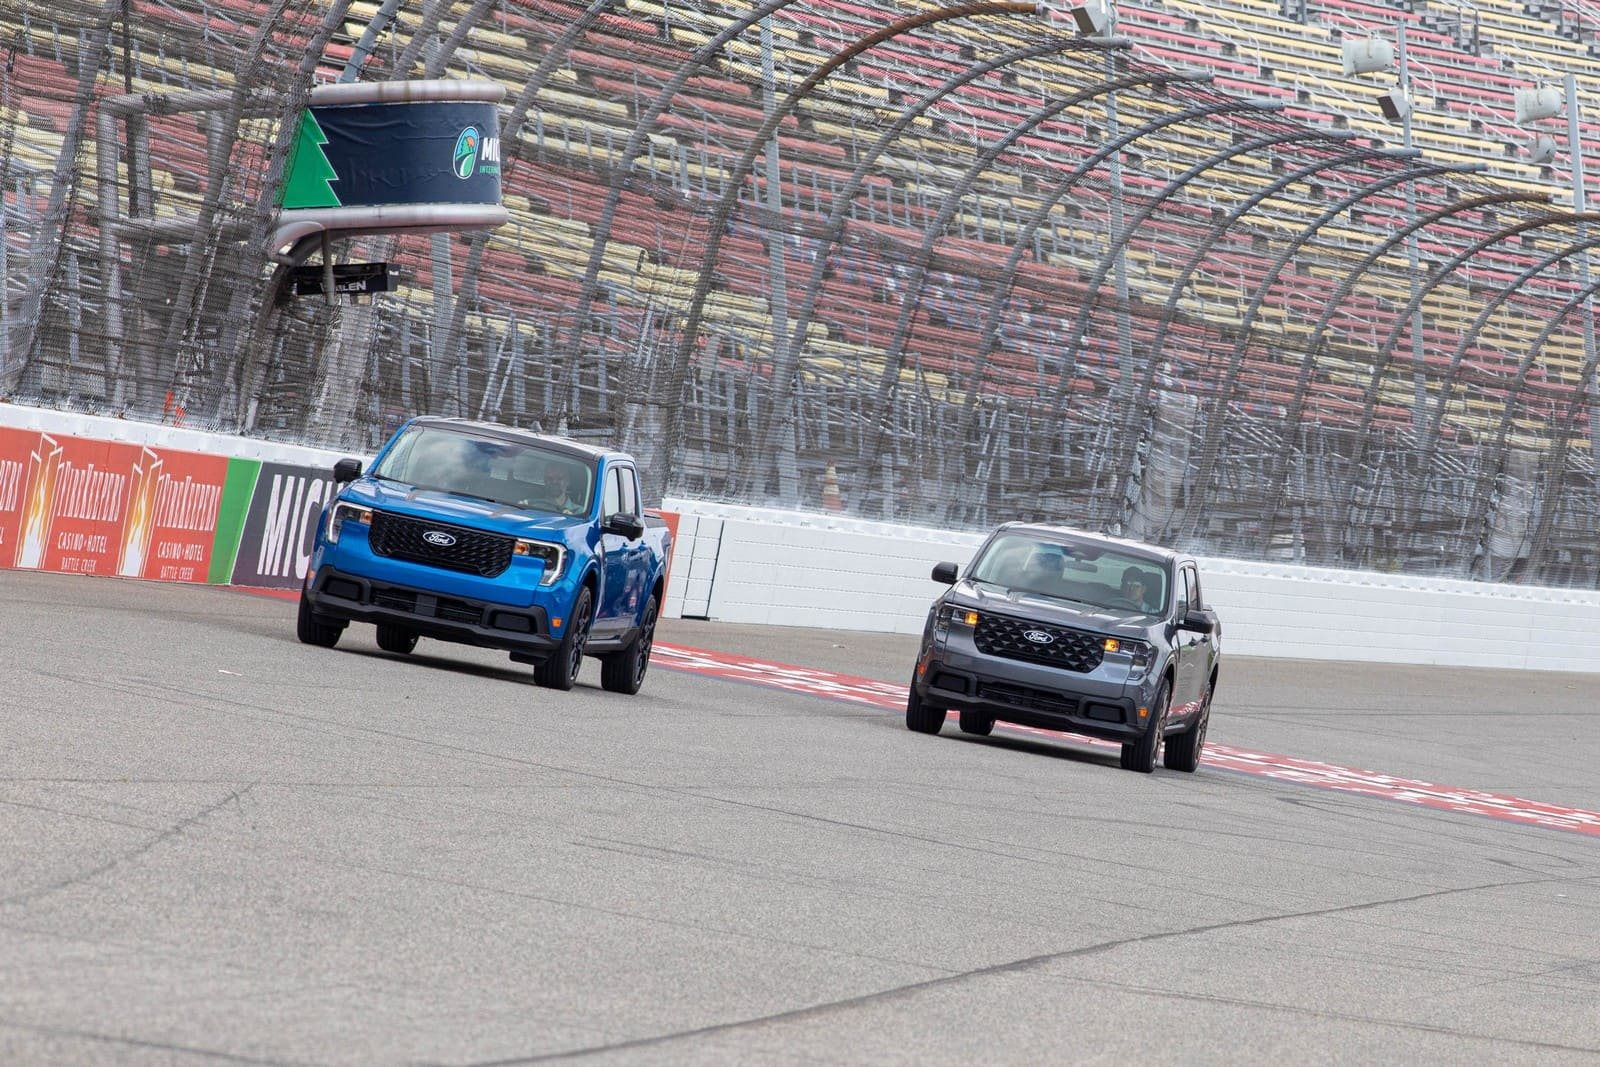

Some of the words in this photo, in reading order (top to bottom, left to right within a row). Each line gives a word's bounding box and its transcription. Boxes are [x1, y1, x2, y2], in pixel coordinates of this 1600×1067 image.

[319, 280, 367, 293] LEN
[57, 461, 125, 522] FIREKEEPERS
[157, 473, 221, 532] FIREKEEPERS
[58, 532, 84, 551] CASINO
[87, 534, 107, 553] HOTEL
[426, 532, 452, 545] Ford
[157, 541, 182, 560] CASINO
[184, 543, 204, 561] HOTEL
[1027, 631, 1050, 642] Ford
